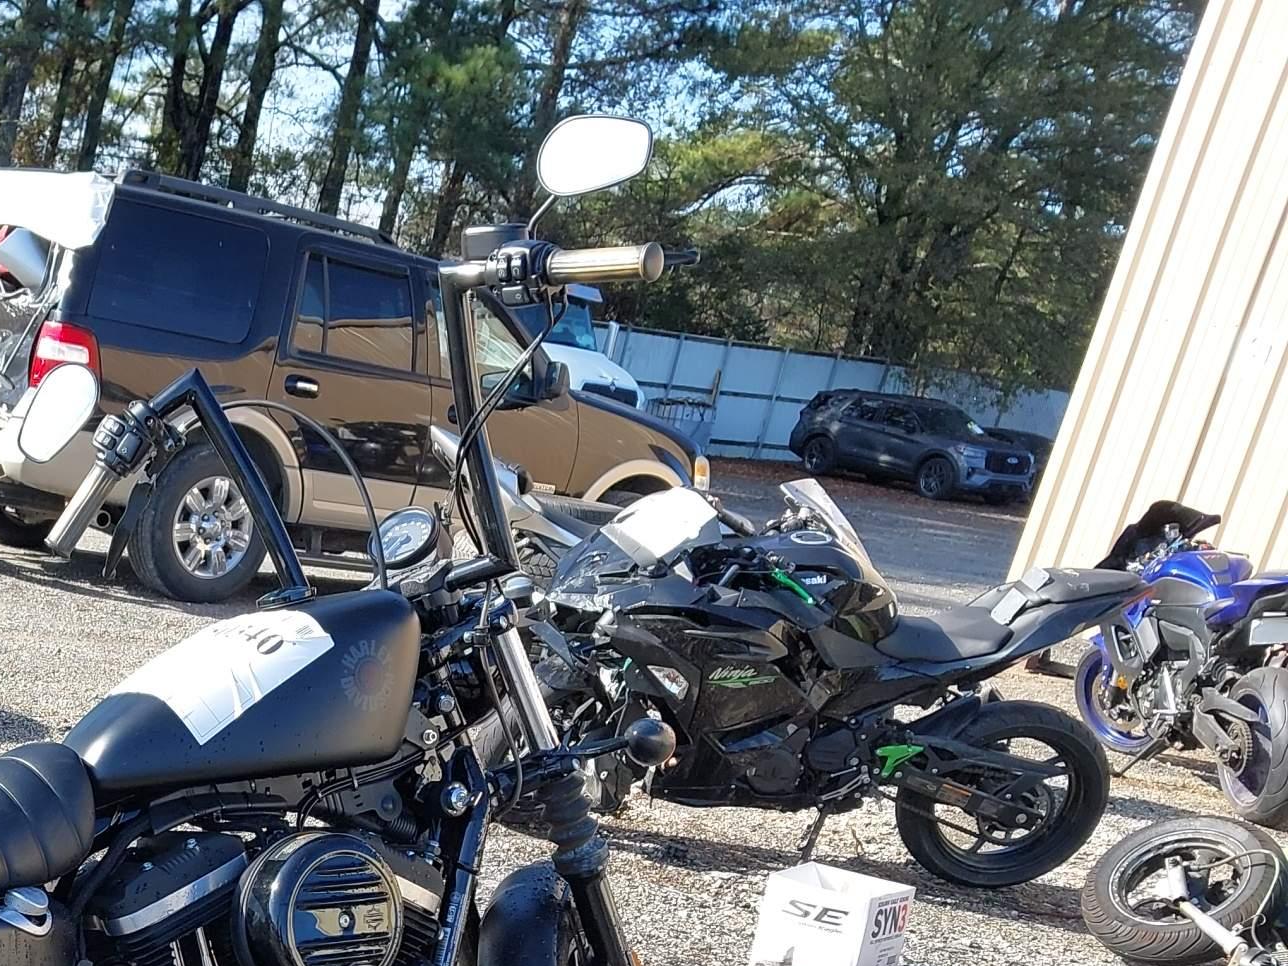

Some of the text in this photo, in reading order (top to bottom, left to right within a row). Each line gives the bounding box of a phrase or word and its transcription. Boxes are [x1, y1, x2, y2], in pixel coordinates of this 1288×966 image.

[708, 664, 758, 681] Ninja
[782, 899, 850, 926] SE
[871, 904, 908, 939] SYN3
